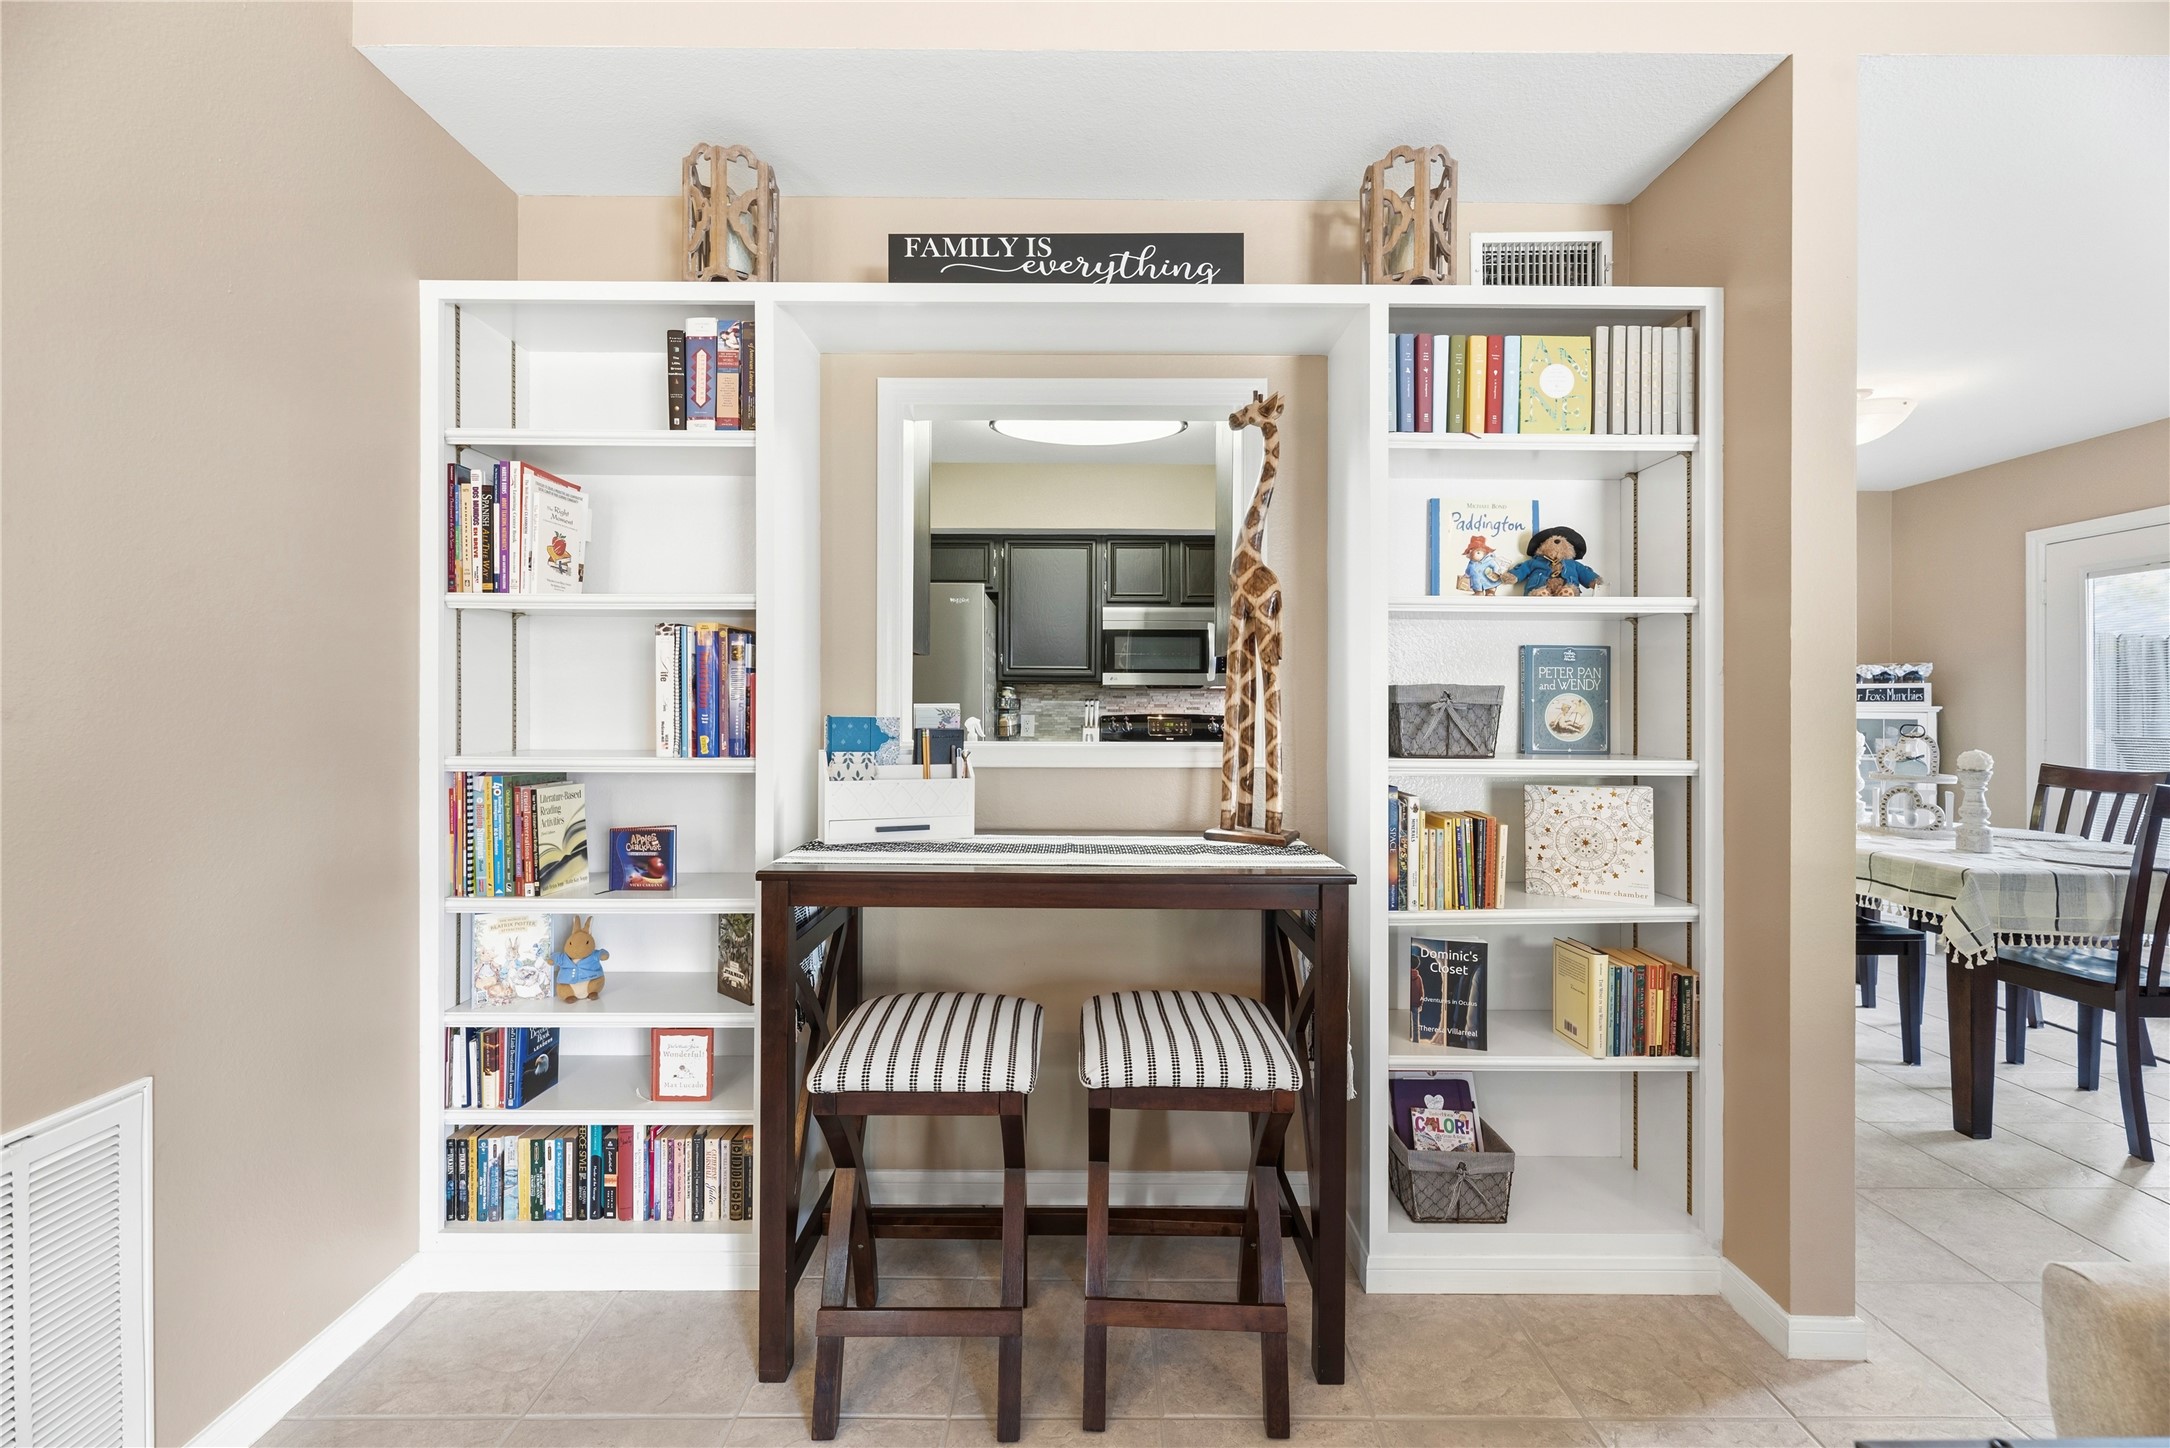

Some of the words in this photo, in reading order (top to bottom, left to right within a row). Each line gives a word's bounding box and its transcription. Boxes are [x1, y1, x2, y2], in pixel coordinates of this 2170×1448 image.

[904, 237, 1019, 258] FAMILY
[1026, 237, 1052, 258] IS
[1016, 244, 1220, 284] everything
[554, 507, 569, 517] Right
[551, 513, 573, 525] Moment
[1452, 512, 1526, 537] Paddington
[473, 527, 478, 536] EN
[1539, 667, 1574, 678] PETER
[1577, 667, 1601, 678] PAN
[731, 668, 745, 701] ECONOMICS
[1539, 680, 1556, 690] and
[1558, 679, 1601, 690] WENDY
[1866, 689, 1885, 701] Fox's
[1887, 688, 1923, 701] Munchies
[492, 783, 503, 796] 40
[540, 790, 581, 804] Literature-Based
[541, 805, 561, 815] Reading
[541, 816, 564, 828] Activities
[1614, 891, 1648, 899] chamber
[1420, 948, 1478, 962] Dominic's
[1430, 962, 1468, 975] Closet
[1447, 1028, 1478, 1037] Villarreal
[534, 1038, 552, 1052] LEADERS
[705, 1183, 717, 1205] Julie
